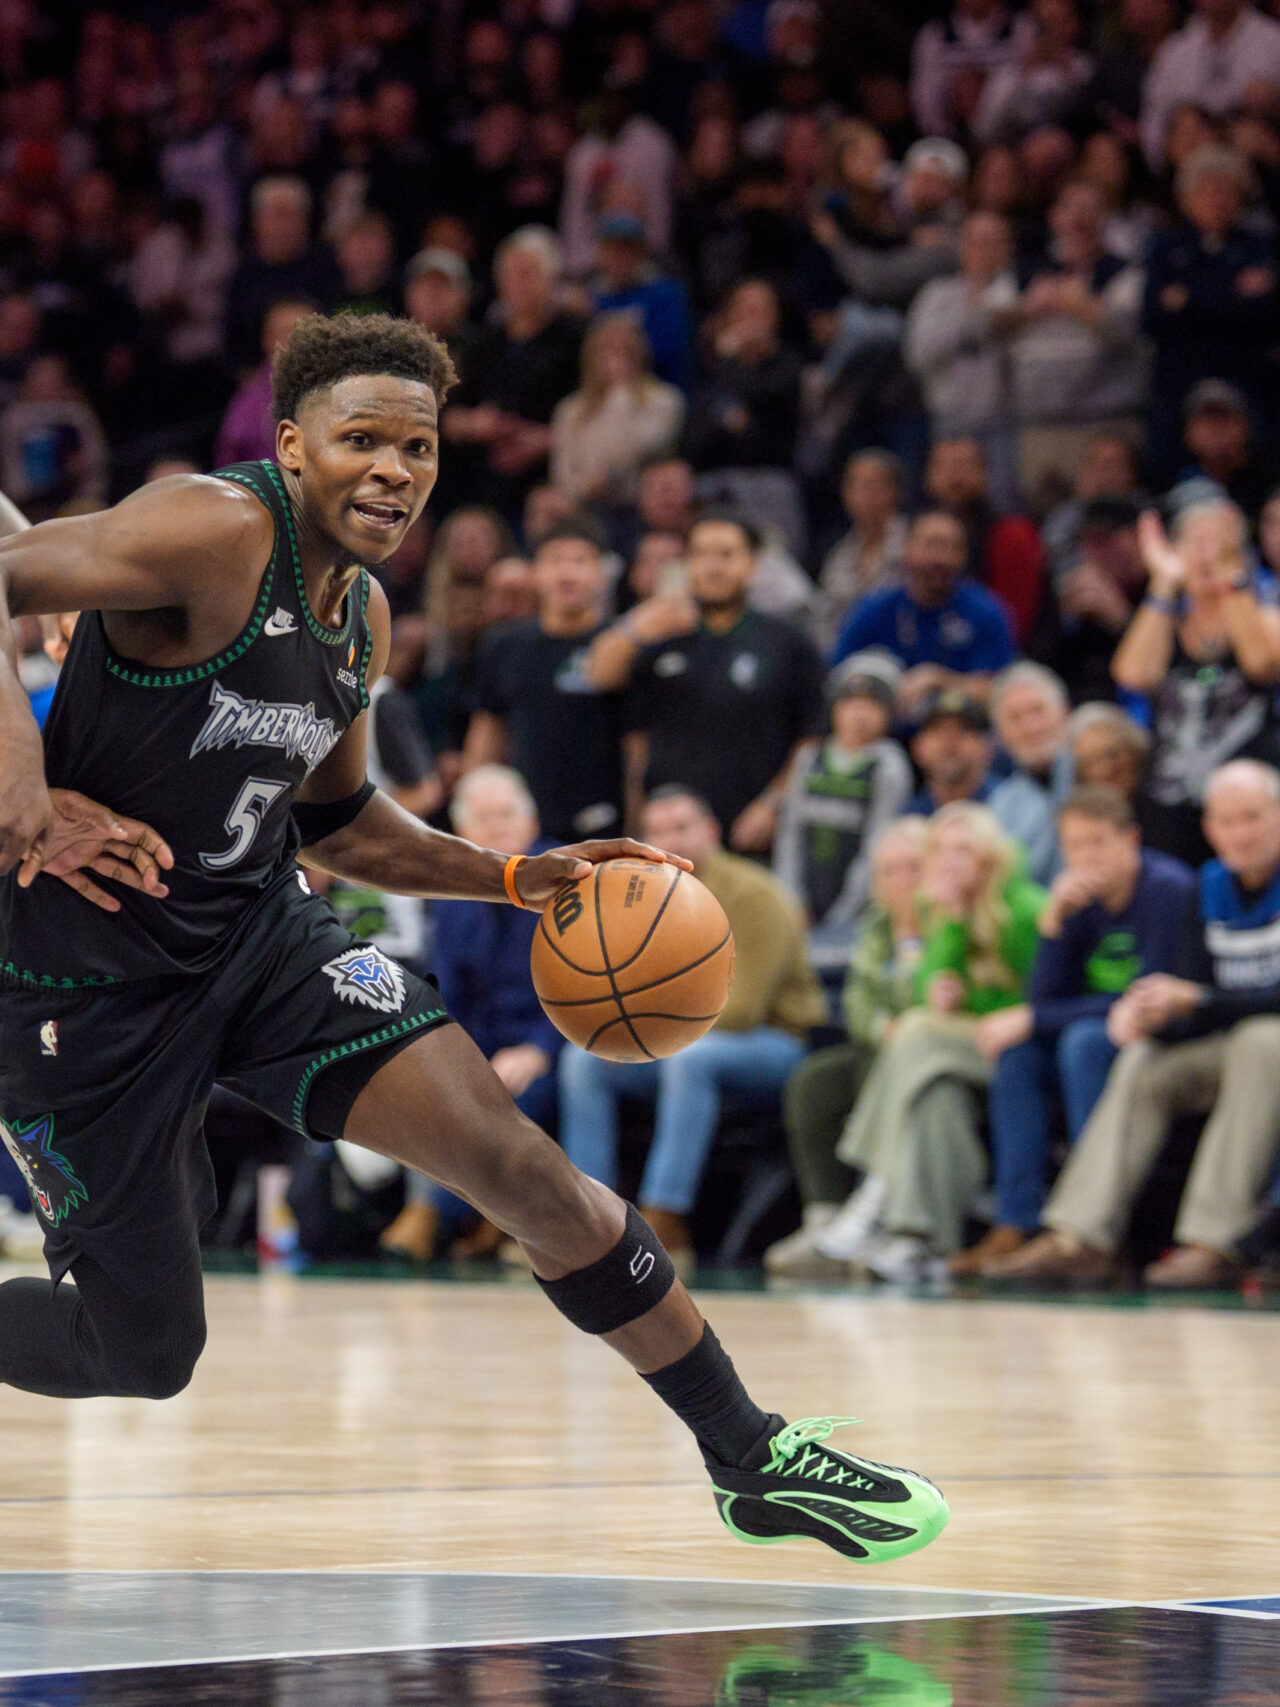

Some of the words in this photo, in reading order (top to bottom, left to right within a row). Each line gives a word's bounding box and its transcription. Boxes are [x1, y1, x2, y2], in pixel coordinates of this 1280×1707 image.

[272, 606, 295, 627] NIKE
[336, 667, 358, 689] sezzle
[198, 775, 292, 871] 5
